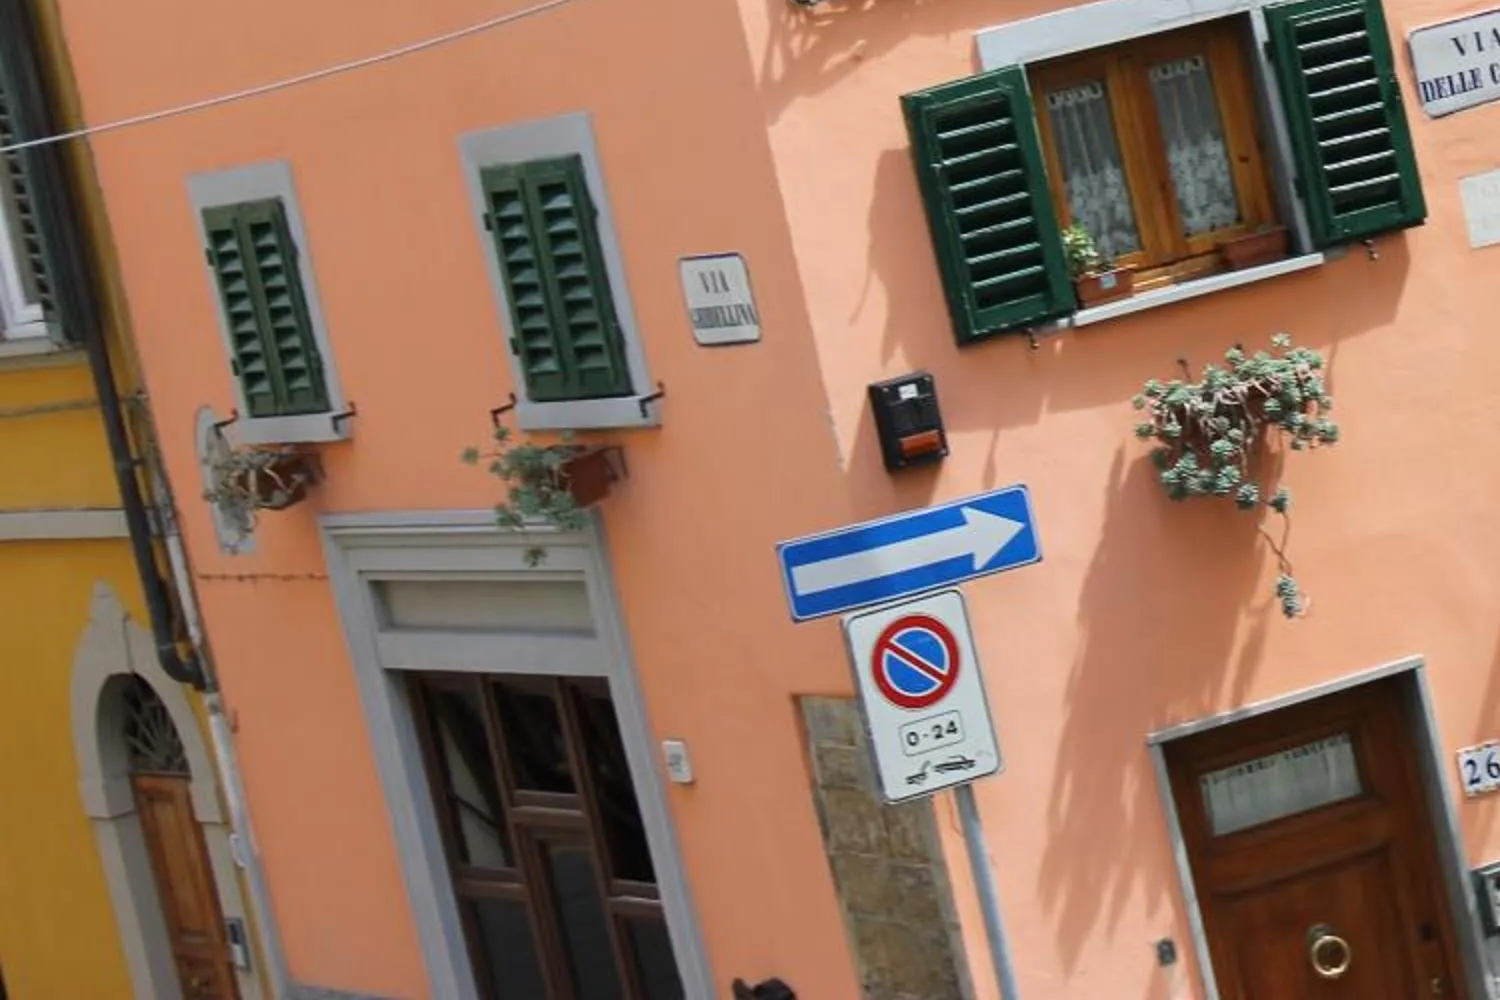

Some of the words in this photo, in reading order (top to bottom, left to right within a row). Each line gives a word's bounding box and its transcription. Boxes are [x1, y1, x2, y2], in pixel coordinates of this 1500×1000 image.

[1420, 67, 1483, 103] DELLE
[698, 269, 731, 294] VIA
[906, 719, 959, 747] 0-24
